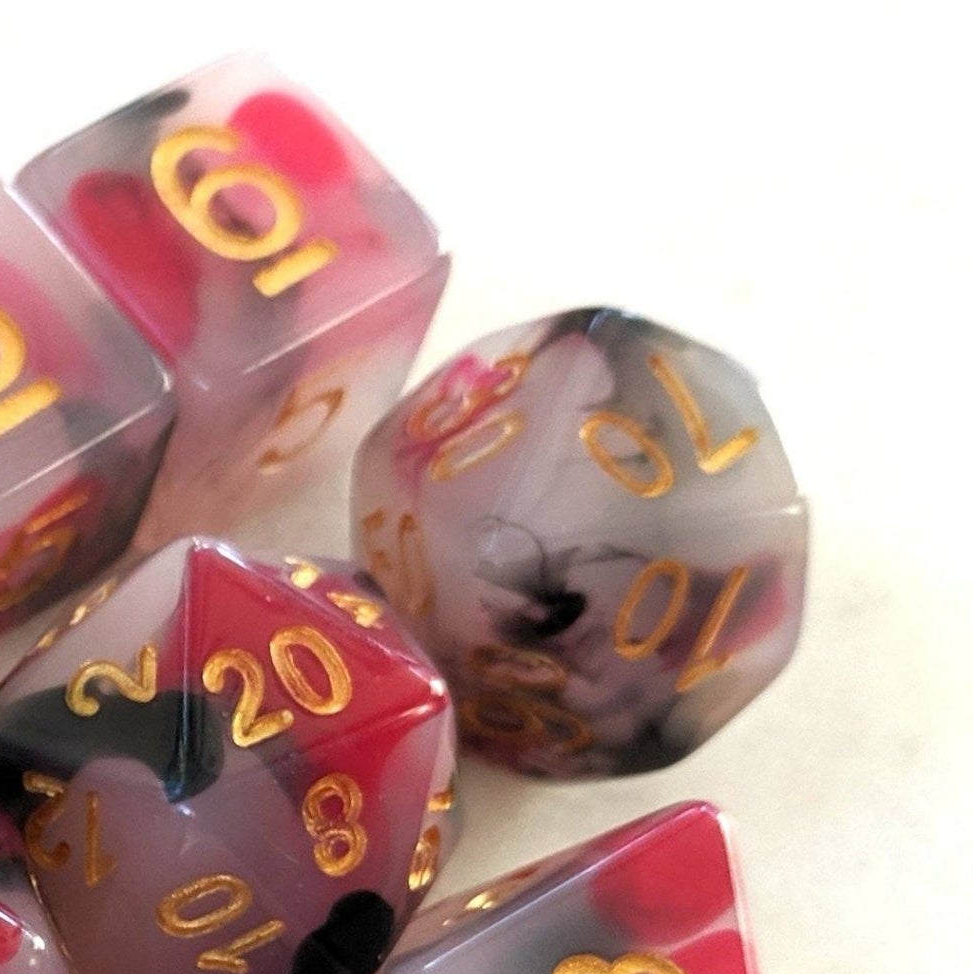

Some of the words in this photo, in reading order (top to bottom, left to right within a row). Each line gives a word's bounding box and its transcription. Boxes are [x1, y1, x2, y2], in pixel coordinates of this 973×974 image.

[579, 354, 760, 499] 70
[66, 643, 157, 716] 2
[614, 558, 750, 693] 10
[203, 625, 352, 747] 20
[23, 771, 117, 887] 12
[301, 773, 367, 876] 8
[156, 873, 284, 974] 10
